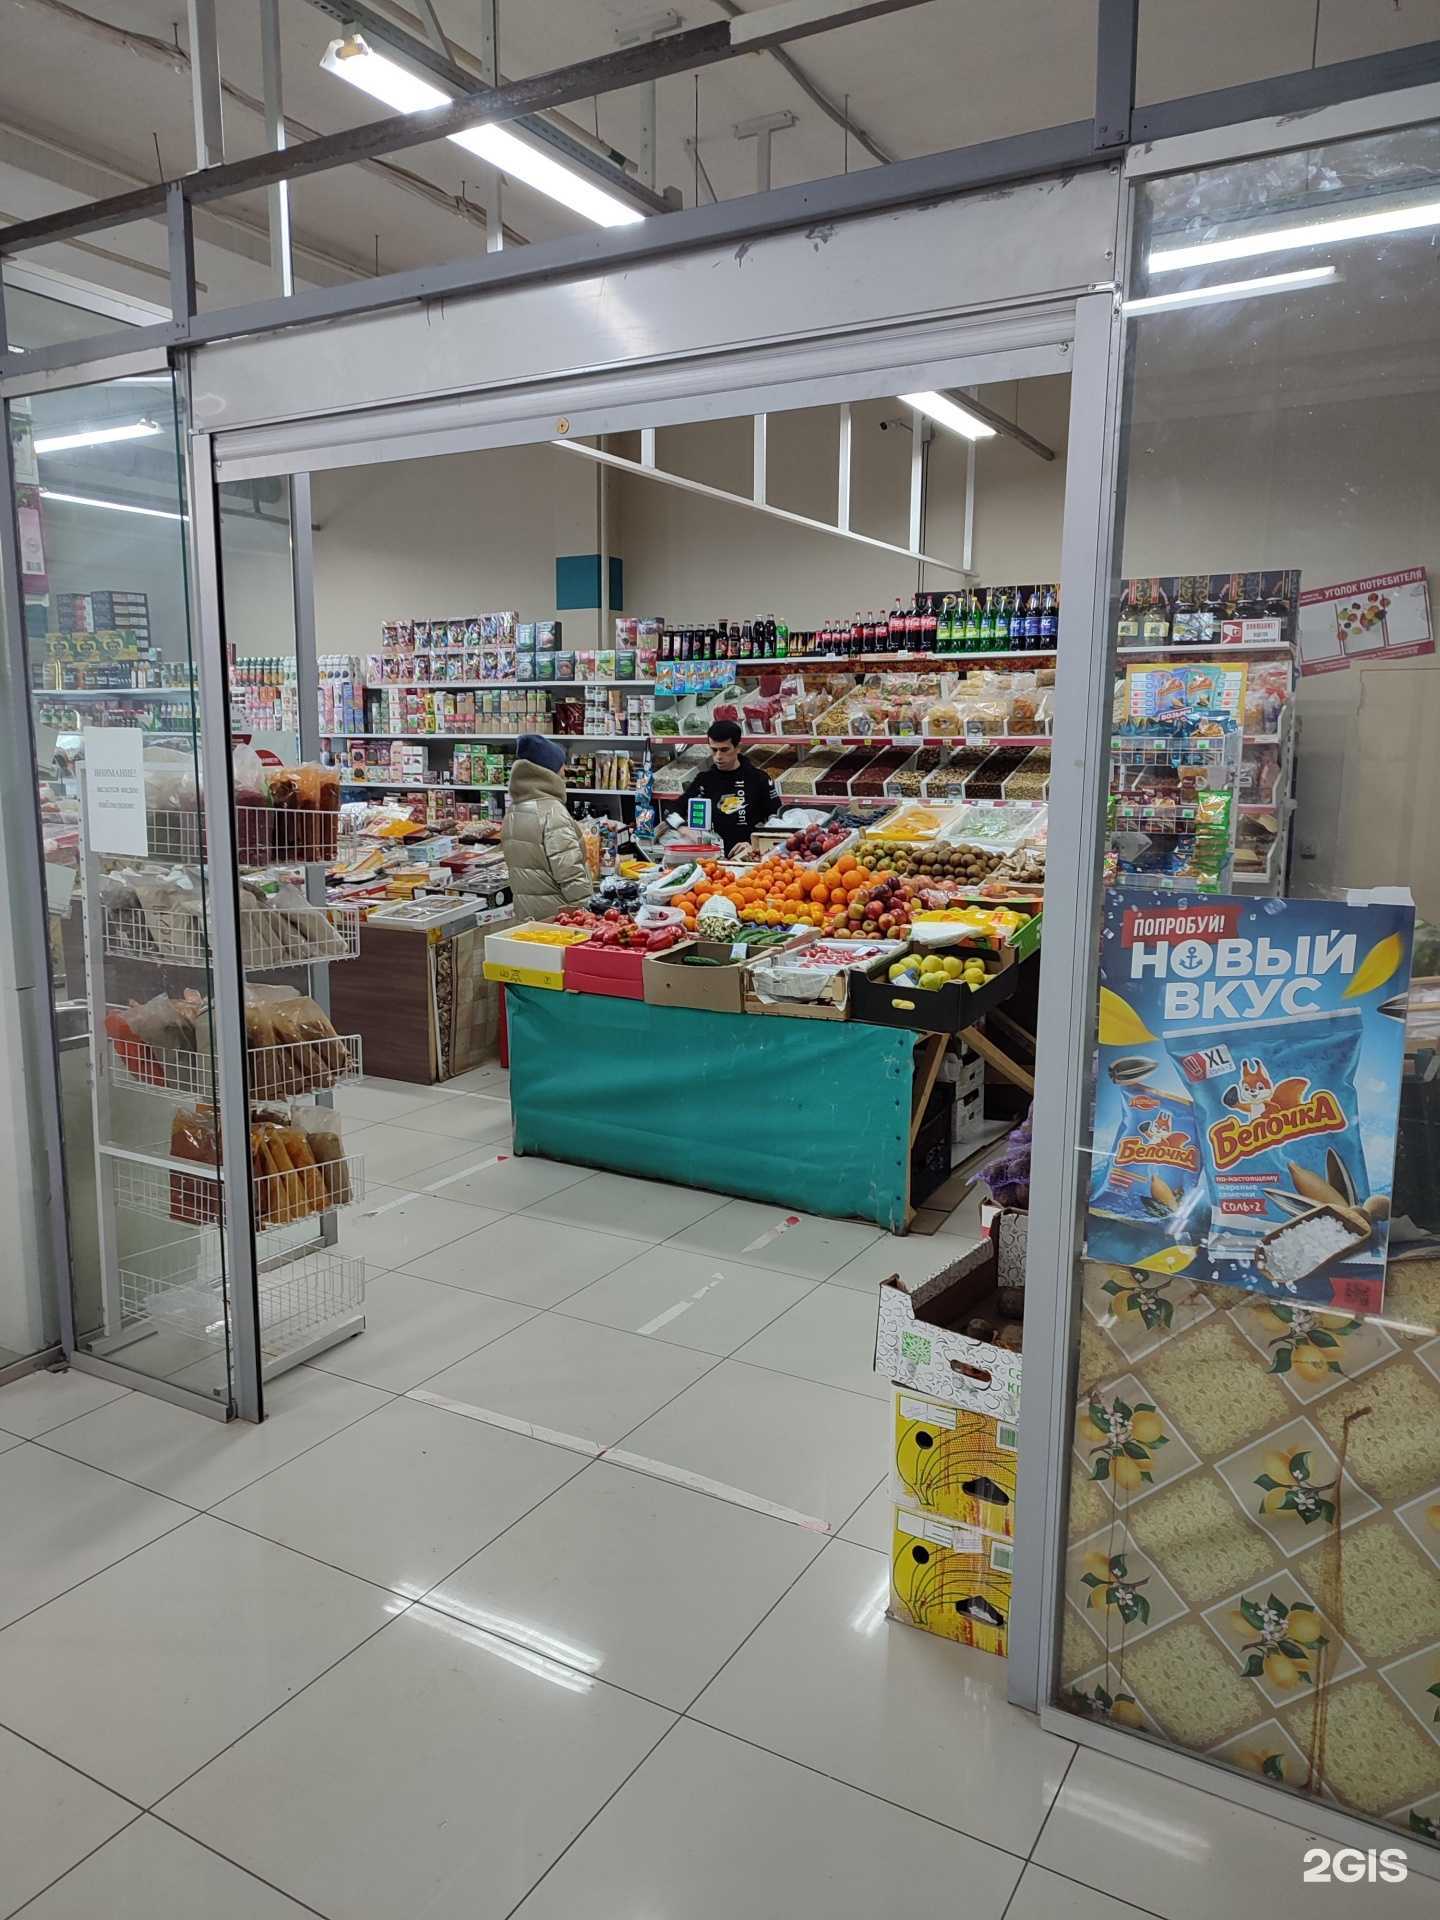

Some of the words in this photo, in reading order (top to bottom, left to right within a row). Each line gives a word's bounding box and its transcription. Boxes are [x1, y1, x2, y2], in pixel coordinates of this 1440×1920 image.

[1324, 583, 1358, 597] УГОЛОК
[1360, 569, 1423, 591] ПОТРЕБИТЕЛЯ
[1133, 914, 1226, 936] ПОПРОБУЙ!
[1130, 929, 1357, 979] НОВЫЙ
[1164, 977, 1323, 1020] ВКУС
[1204, 1048, 1229, 1068] XL
